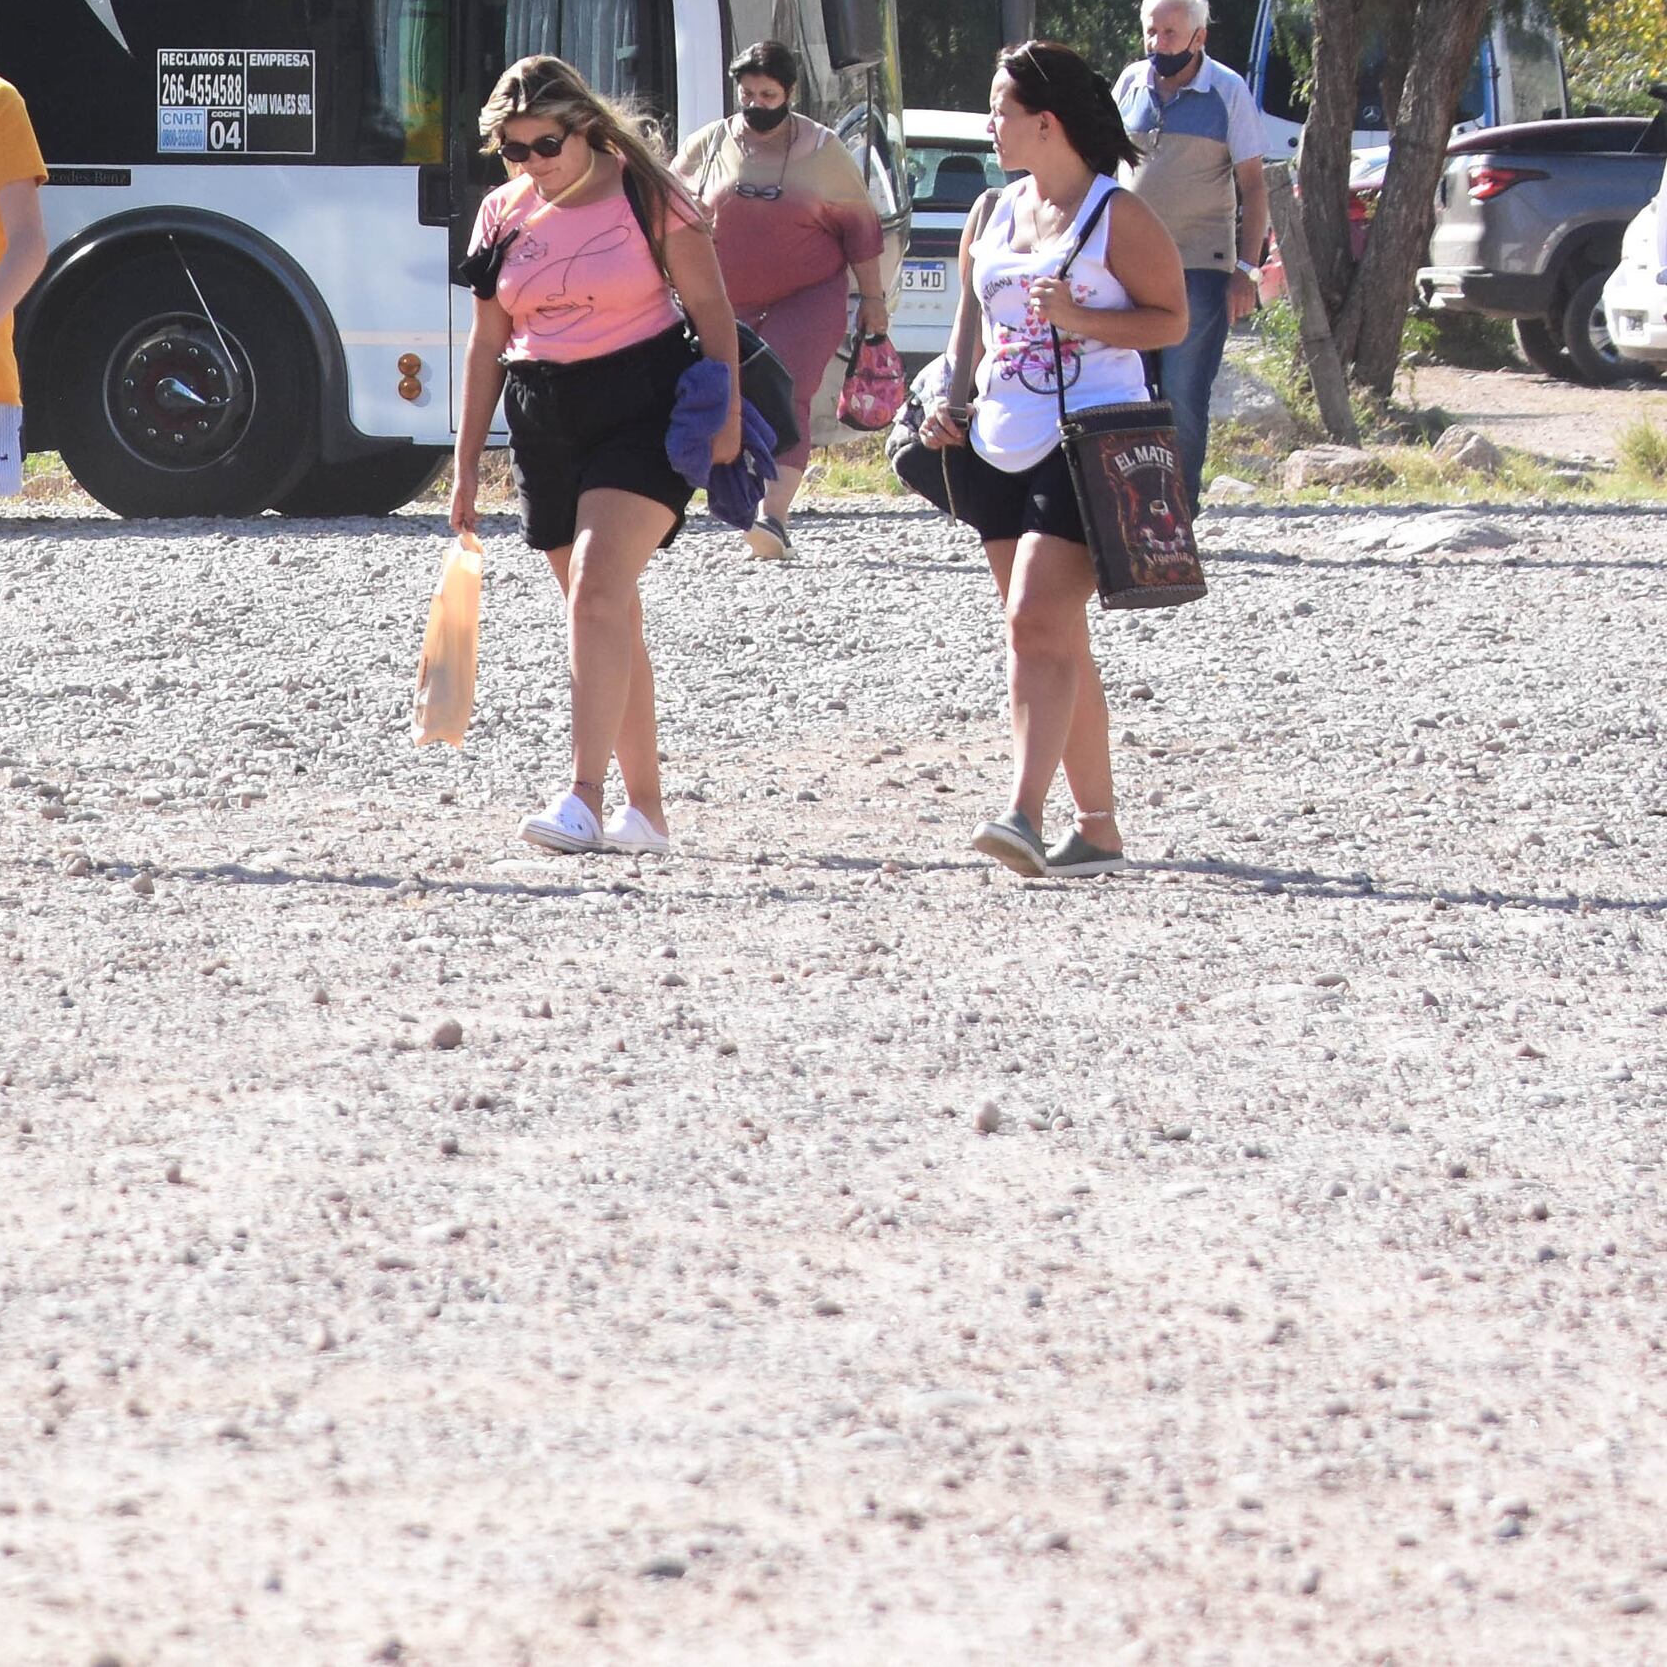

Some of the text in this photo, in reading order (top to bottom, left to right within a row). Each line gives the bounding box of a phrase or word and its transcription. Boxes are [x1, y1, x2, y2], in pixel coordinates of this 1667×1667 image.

[161, 53, 243, 66] RECLAMOS AL
[249, 53, 310, 67] EMPRESA
[162, 73, 242, 106] 266-4554588
[247, 93, 268, 115] SAMI
[269, 93, 296, 115] VIAJES
[162, 112, 203, 125] CNRT
[210, 120, 242, 150] 04
[1114, 452, 1136, 472] EL
[1133, 445, 1175, 468] MATE
